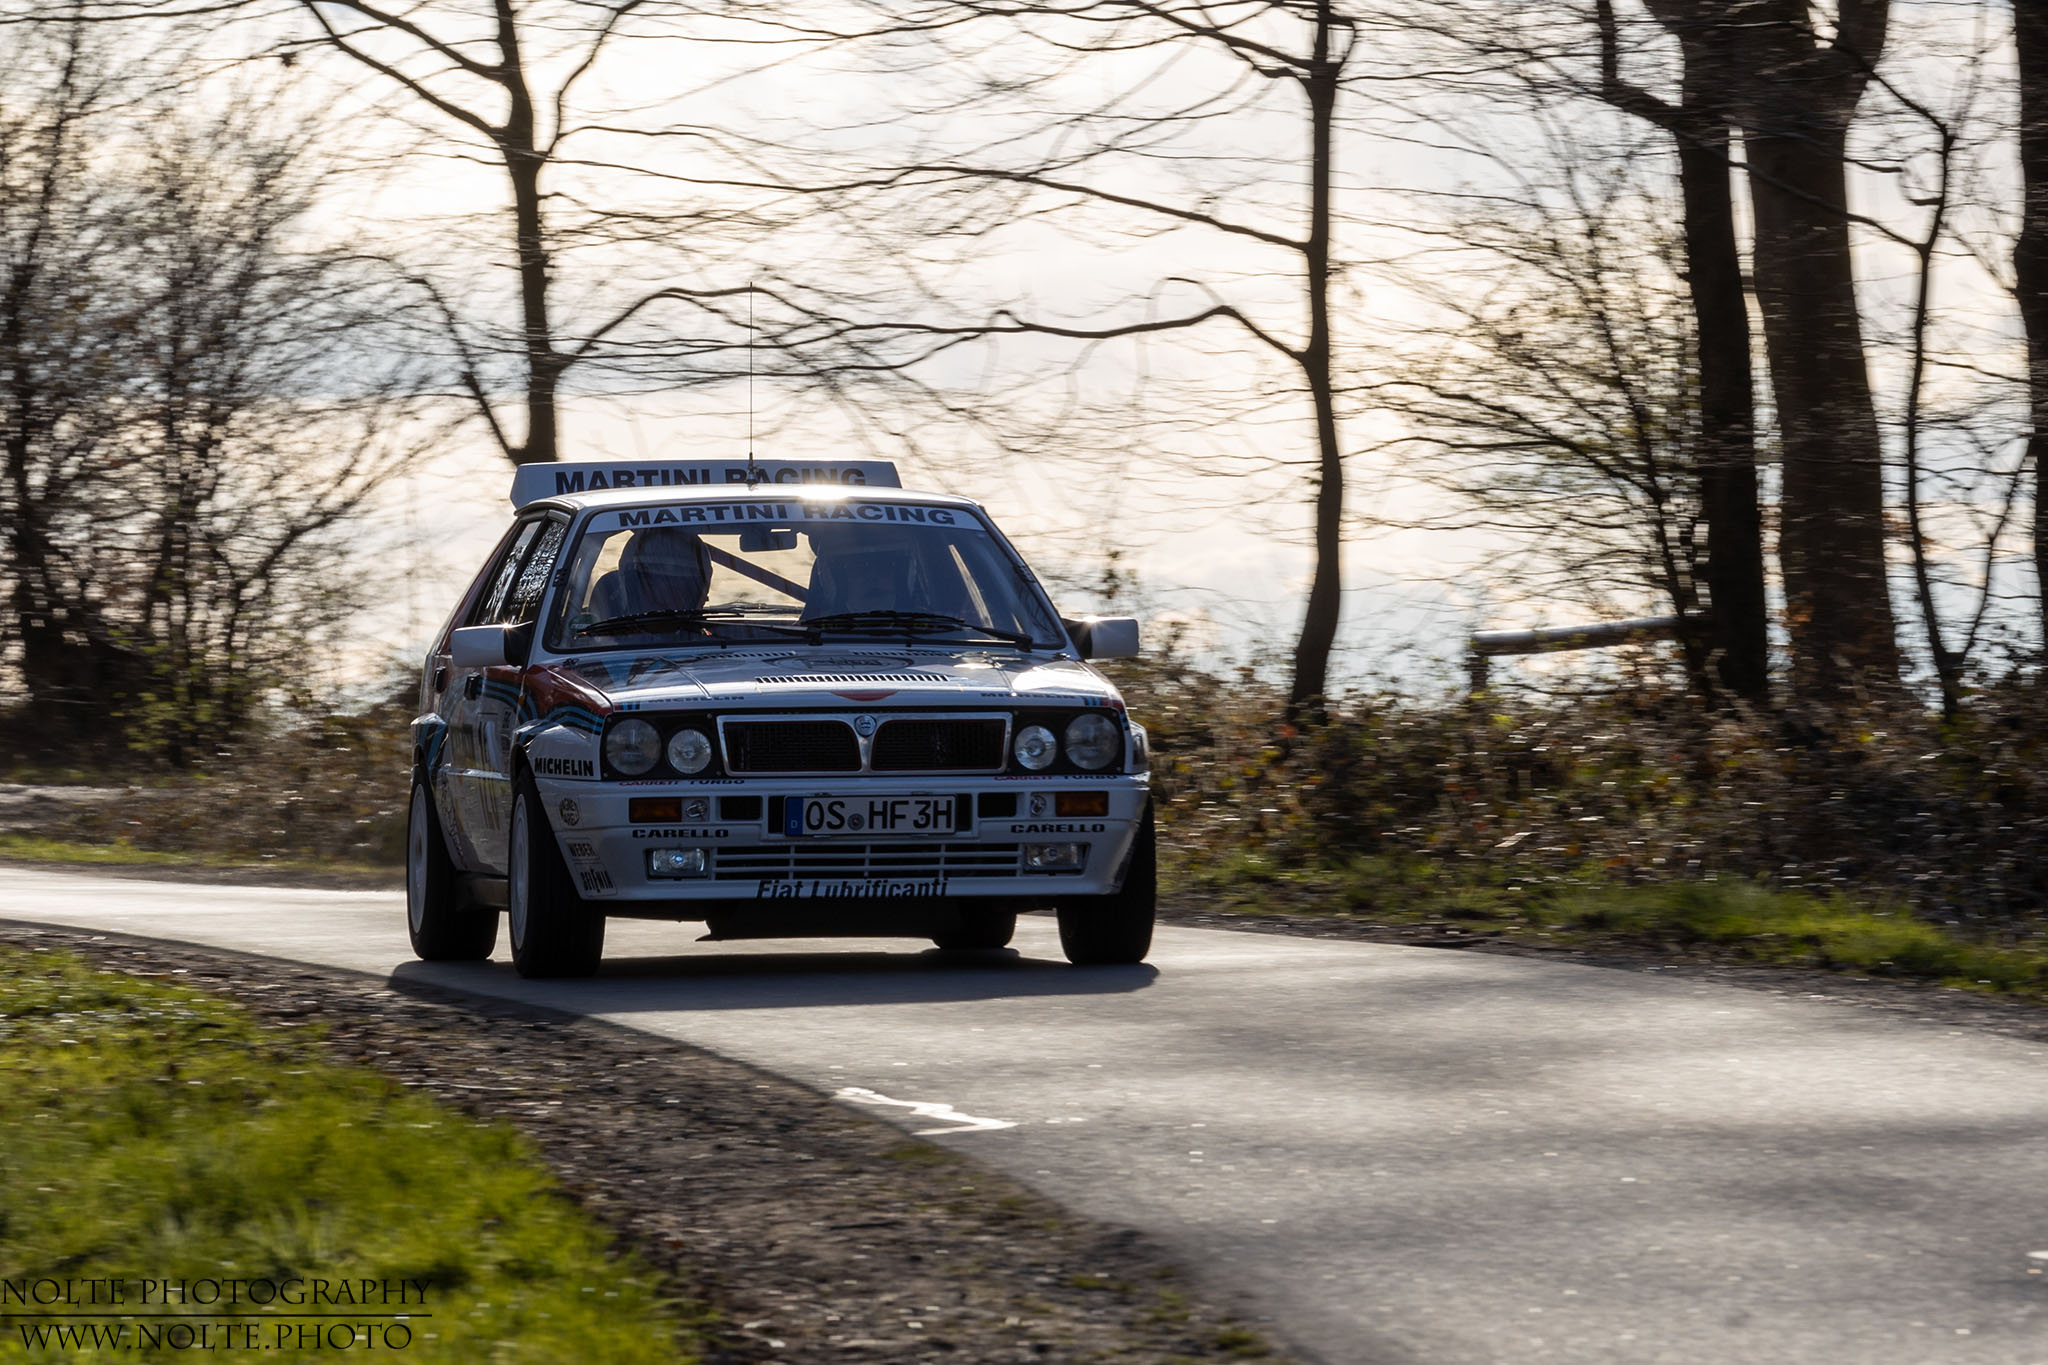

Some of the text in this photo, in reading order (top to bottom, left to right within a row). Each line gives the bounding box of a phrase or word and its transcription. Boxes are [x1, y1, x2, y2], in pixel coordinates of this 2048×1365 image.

[556, 468, 866, 494] MARTINI RACING
[619, 503, 956, 527] MARTINI RACING
[534, 757, 594, 777] MICHELIN
[805, 800, 953, 831] OS HF 3H
[632, 829, 729, 838] CARELLO
[1010, 823, 1105, 833] CARELLO
[756, 877, 949, 899] Fiat Lubrificanti
